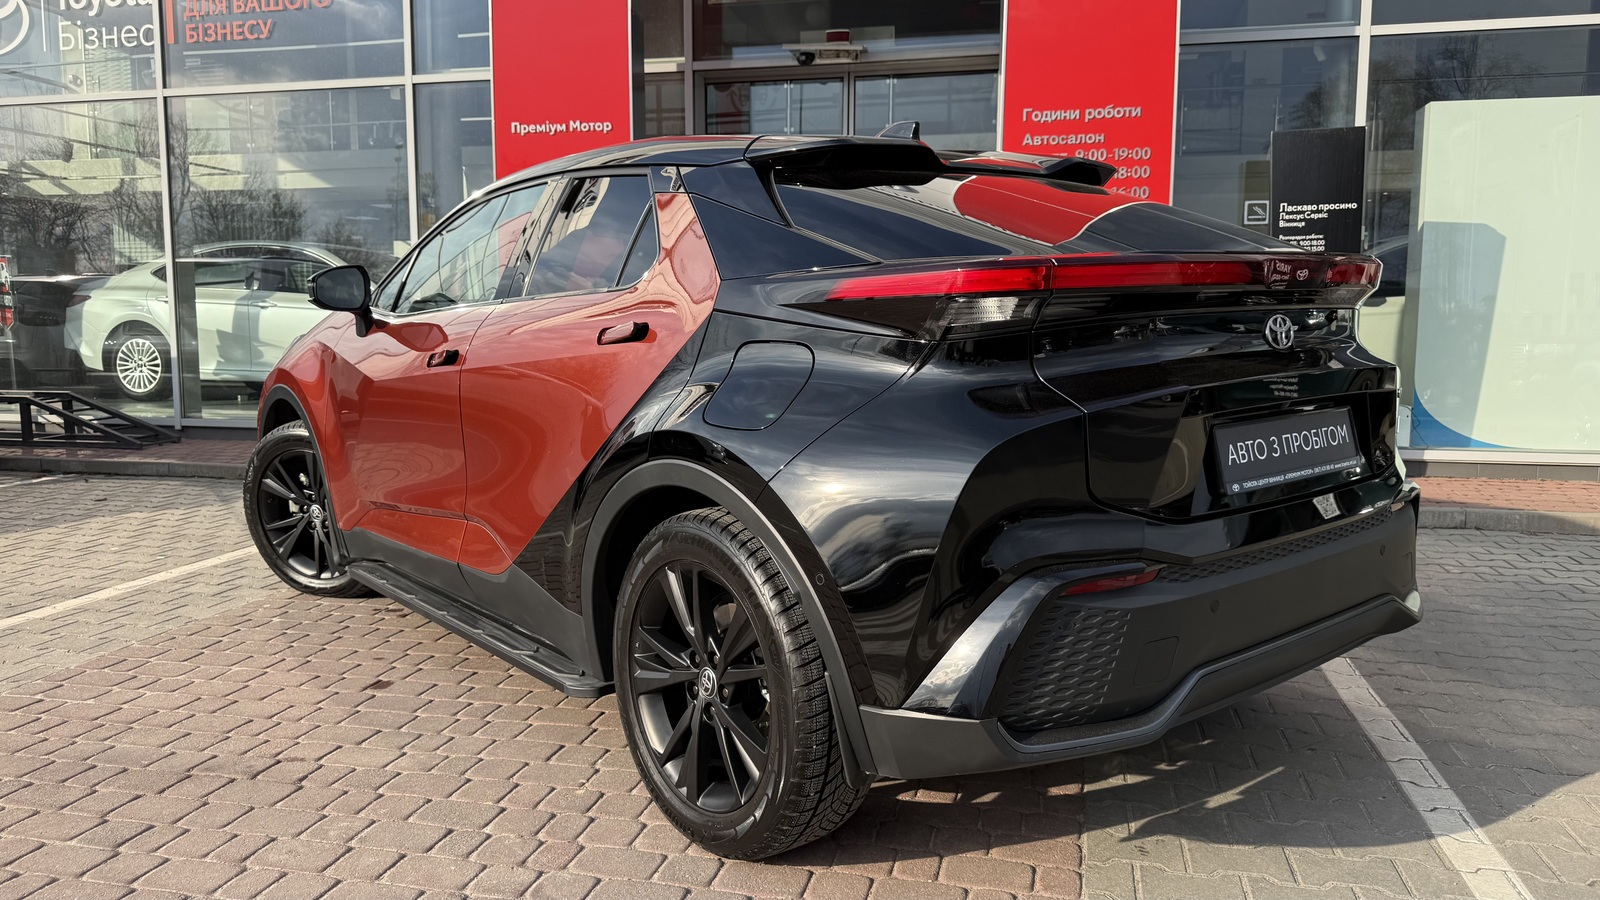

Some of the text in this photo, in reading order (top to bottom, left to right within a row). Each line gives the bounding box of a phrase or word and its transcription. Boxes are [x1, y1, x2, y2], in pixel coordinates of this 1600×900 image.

[58, 19, 155, 51] Бізнес
[185, 18, 273, 44] БІЗНЕСУ
[1022, 105, 1142, 123] Години роботи
[510, 119, 613, 136] Преміум Мотор
[1022, 132, 1105, 146] Автосалон
[1075, 147, 1151, 161] 9:00-19:00
[1279, 202, 1358, 212] Ласкаво просимо
[1279, 211, 1328, 220] Лексус Сервіс
[1279, 220, 1306, 228] Вінниця
[1228, 424, 1349, 466] АВТО З ПРОБІГОМ
